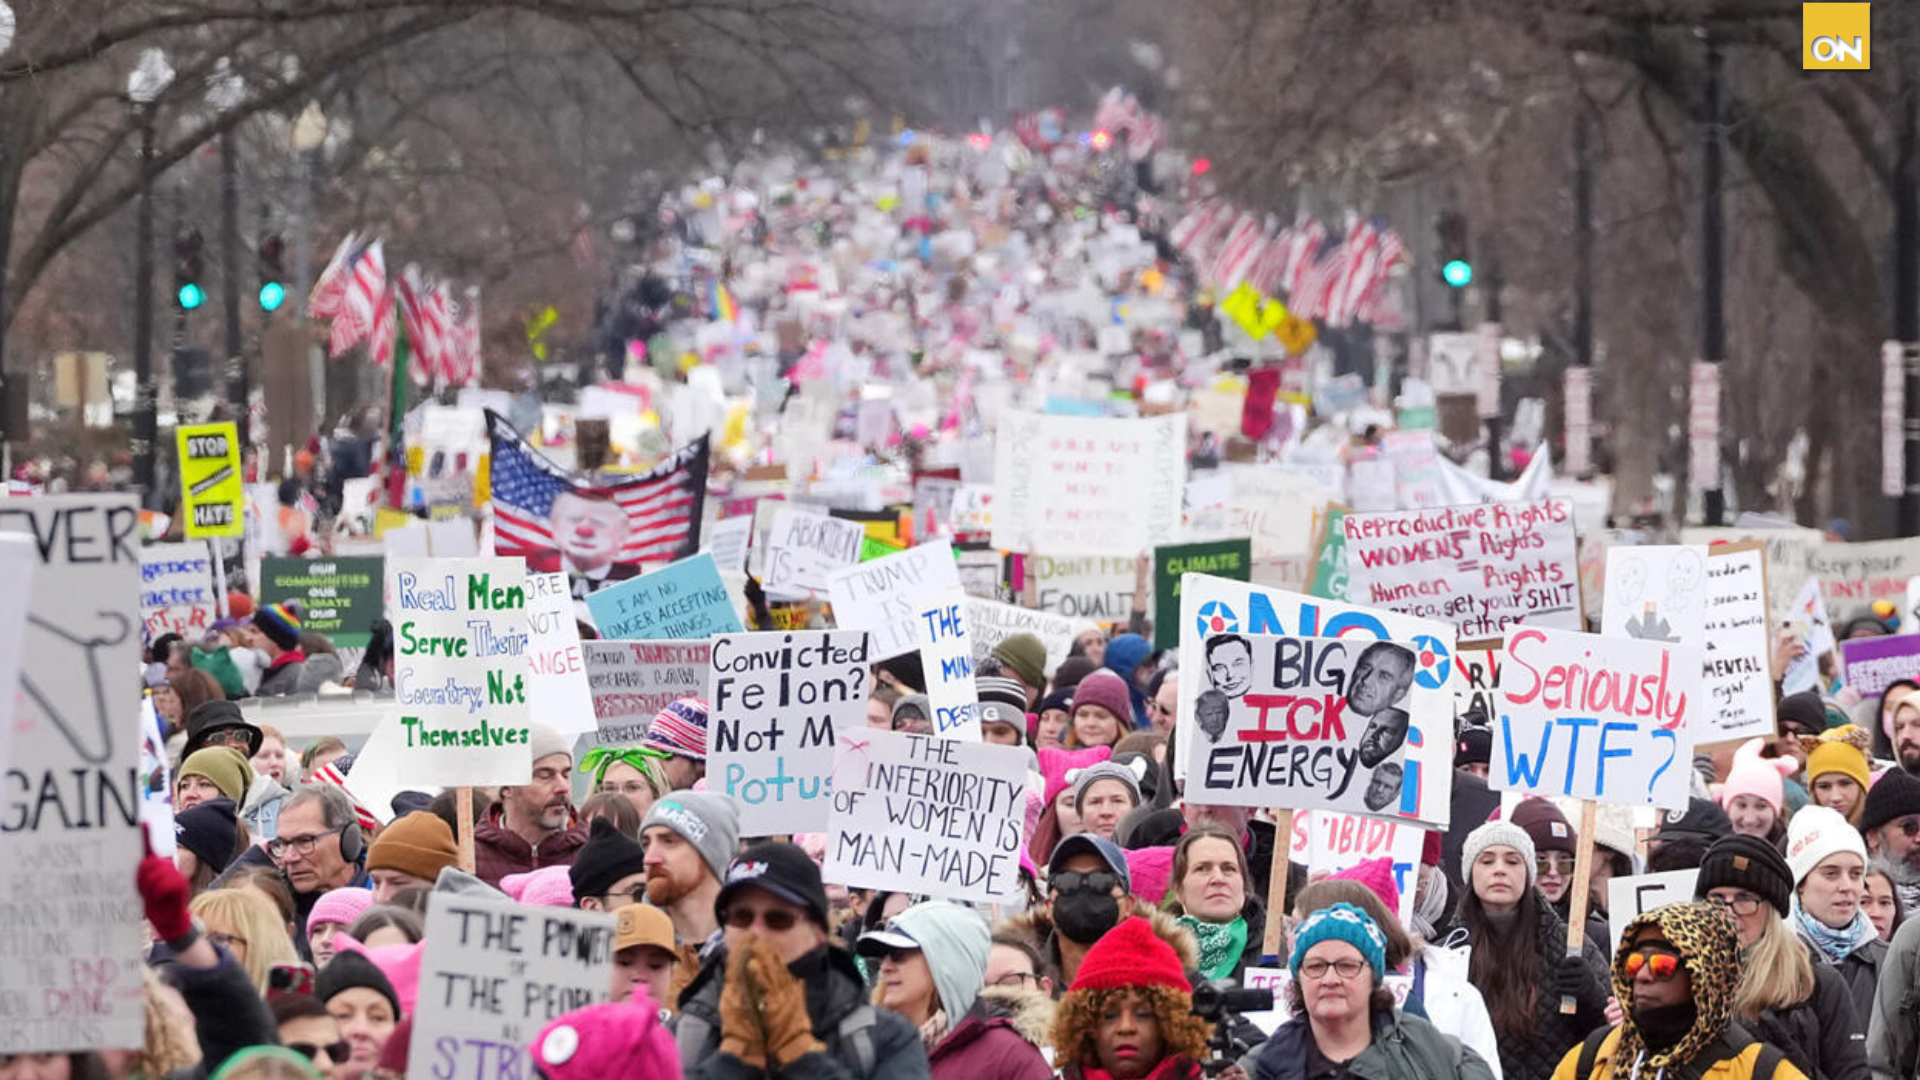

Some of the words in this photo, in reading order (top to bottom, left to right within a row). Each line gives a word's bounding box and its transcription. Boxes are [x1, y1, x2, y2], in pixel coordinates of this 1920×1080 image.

[187, 434, 229, 458] STOP
[0, 505, 138, 563] VER
[193, 503, 234, 527] HATE
[1344, 507, 1487, 540] Reproductive
[1493, 500, 1568, 534] Rights
[1166, 553, 1241, 576] CLIMATE
[1479, 529, 1545, 561] Rights
[307, 587, 337, 598] OUR
[399, 571, 456, 612] Real
[467, 572, 525, 611] Men
[632, 591, 651, 608] AM
[657, 580, 678, 599] NO
[835, 552, 929, 602] TRUMP
[1370, 576, 1452, 604] Human
[1482, 560, 1565, 593] Rights
[308, 608, 337, 619] OUR
[658, 583, 728, 623] ACCEPTING
[1443, 594, 1474, 617] get
[1478, 594, 1523, 618] your
[1526, 584, 1576, 609] SHIT
[303, 618, 343, 629] FIGHT
[400, 621, 468, 658] Serve
[466, 619, 529, 658] Their
[665, 610, 712, 640] THINGS
[921, 604, 965, 643] THE
[712, 630, 869, 673] Convicted
[1273, 637, 1348, 697] BIG
[1702, 655, 1762, 679] MENTAL
[486, 669, 526, 705] Not
[716, 667, 865, 712] Felon?
[1504, 629, 1687, 731] Seriously,
[400, 716, 530, 747] Themselves
[715, 717, 785, 753] Not
[1236, 693, 1350, 743] ICK
[905, 734, 961, 766] THE
[1500, 714, 1676, 804] WTF?
[865, 761, 1025, 819] INFERIORITY
[1204, 740, 1359, 801] ENERGY
[834, 791, 866, 816] OF
[884, 797, 986, 844] WOMEN
[996, 817, 1021, 852] IS
[1291, 808, 1398, 855] SIBIDI
[836, 830, 1009, 896] MAN-MADE
[446, 906, 526, 954] THE
[435, 970, 508, 1015] THE
[523, 982, 609, 1020] PEOP
